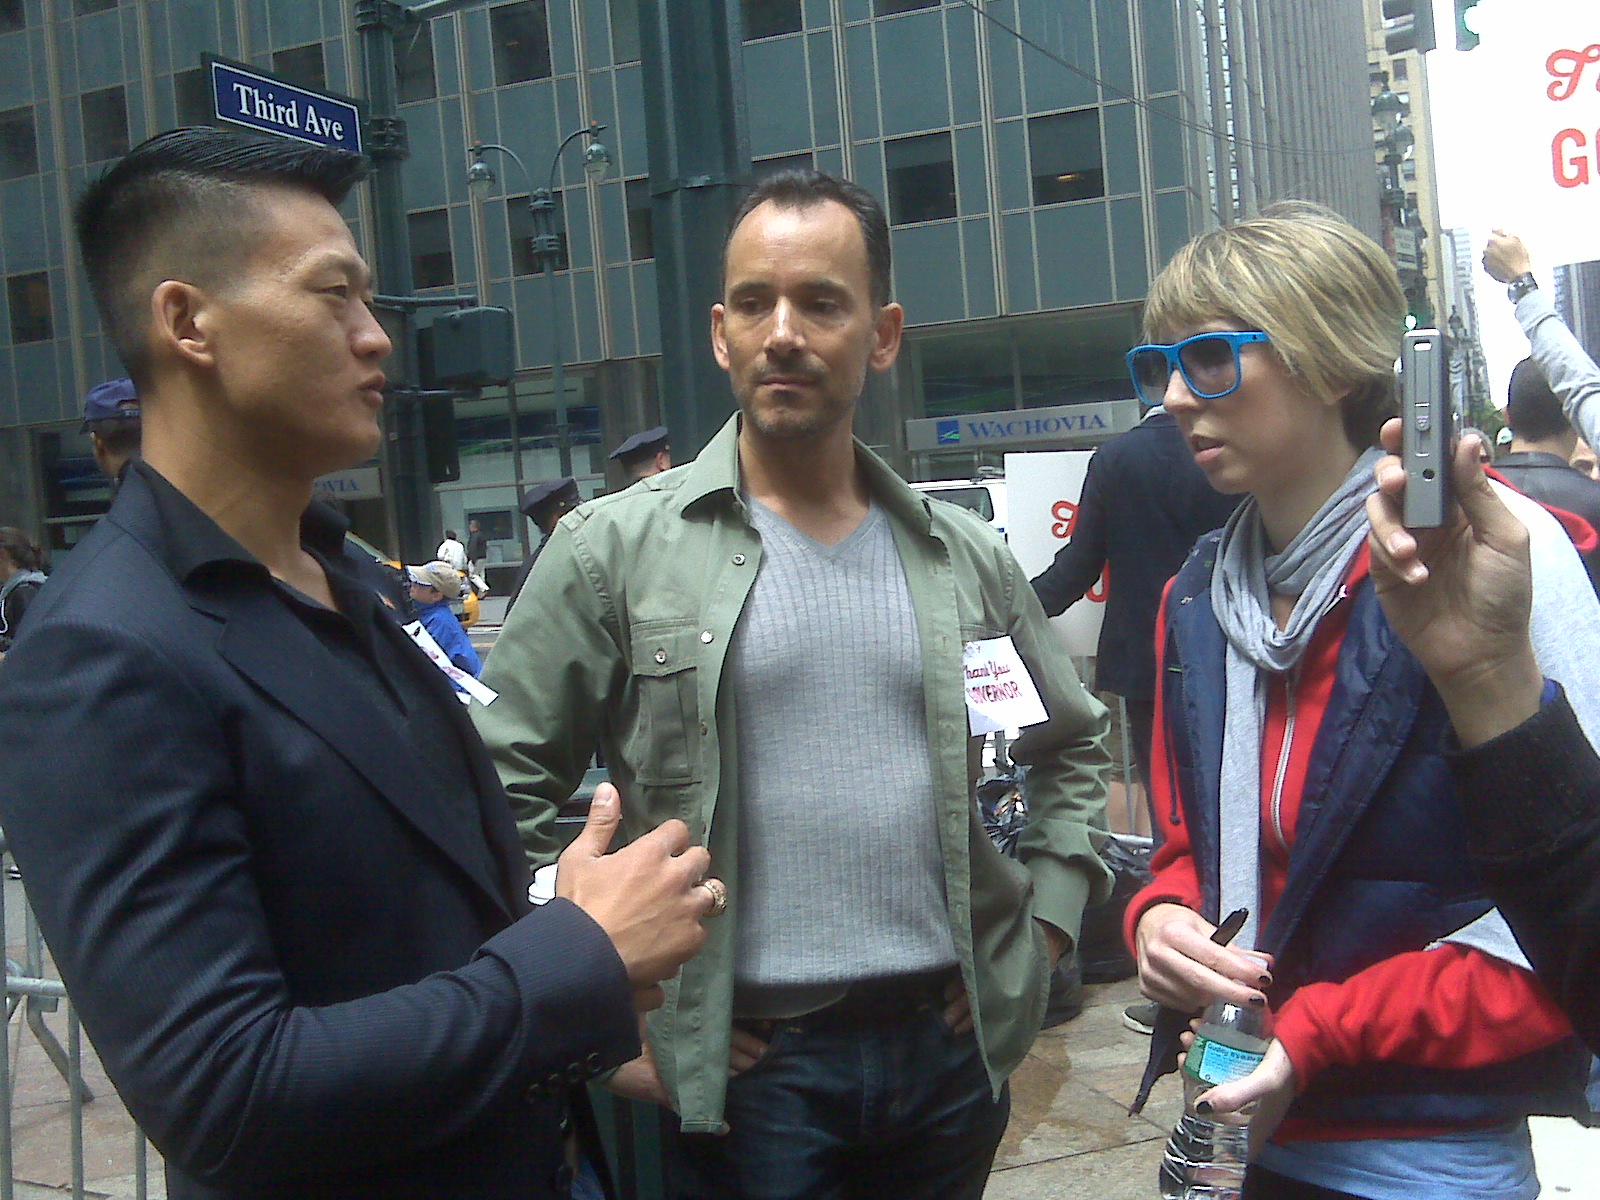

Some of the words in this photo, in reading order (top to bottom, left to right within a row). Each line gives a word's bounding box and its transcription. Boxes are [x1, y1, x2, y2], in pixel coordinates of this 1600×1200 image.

[1545, 43, 1600, 101] T
[232, 82, 300, 129] Third
[304, 104, 344, 141] Ave
[1551, 127, 1600, 188] G
[966, 414, 1107, 439] WACHOVIA
[963, 664, 991, 680] hank
[987, 660, 1011, 681] You
[966, 680, 1023, 704] OVERNOR
